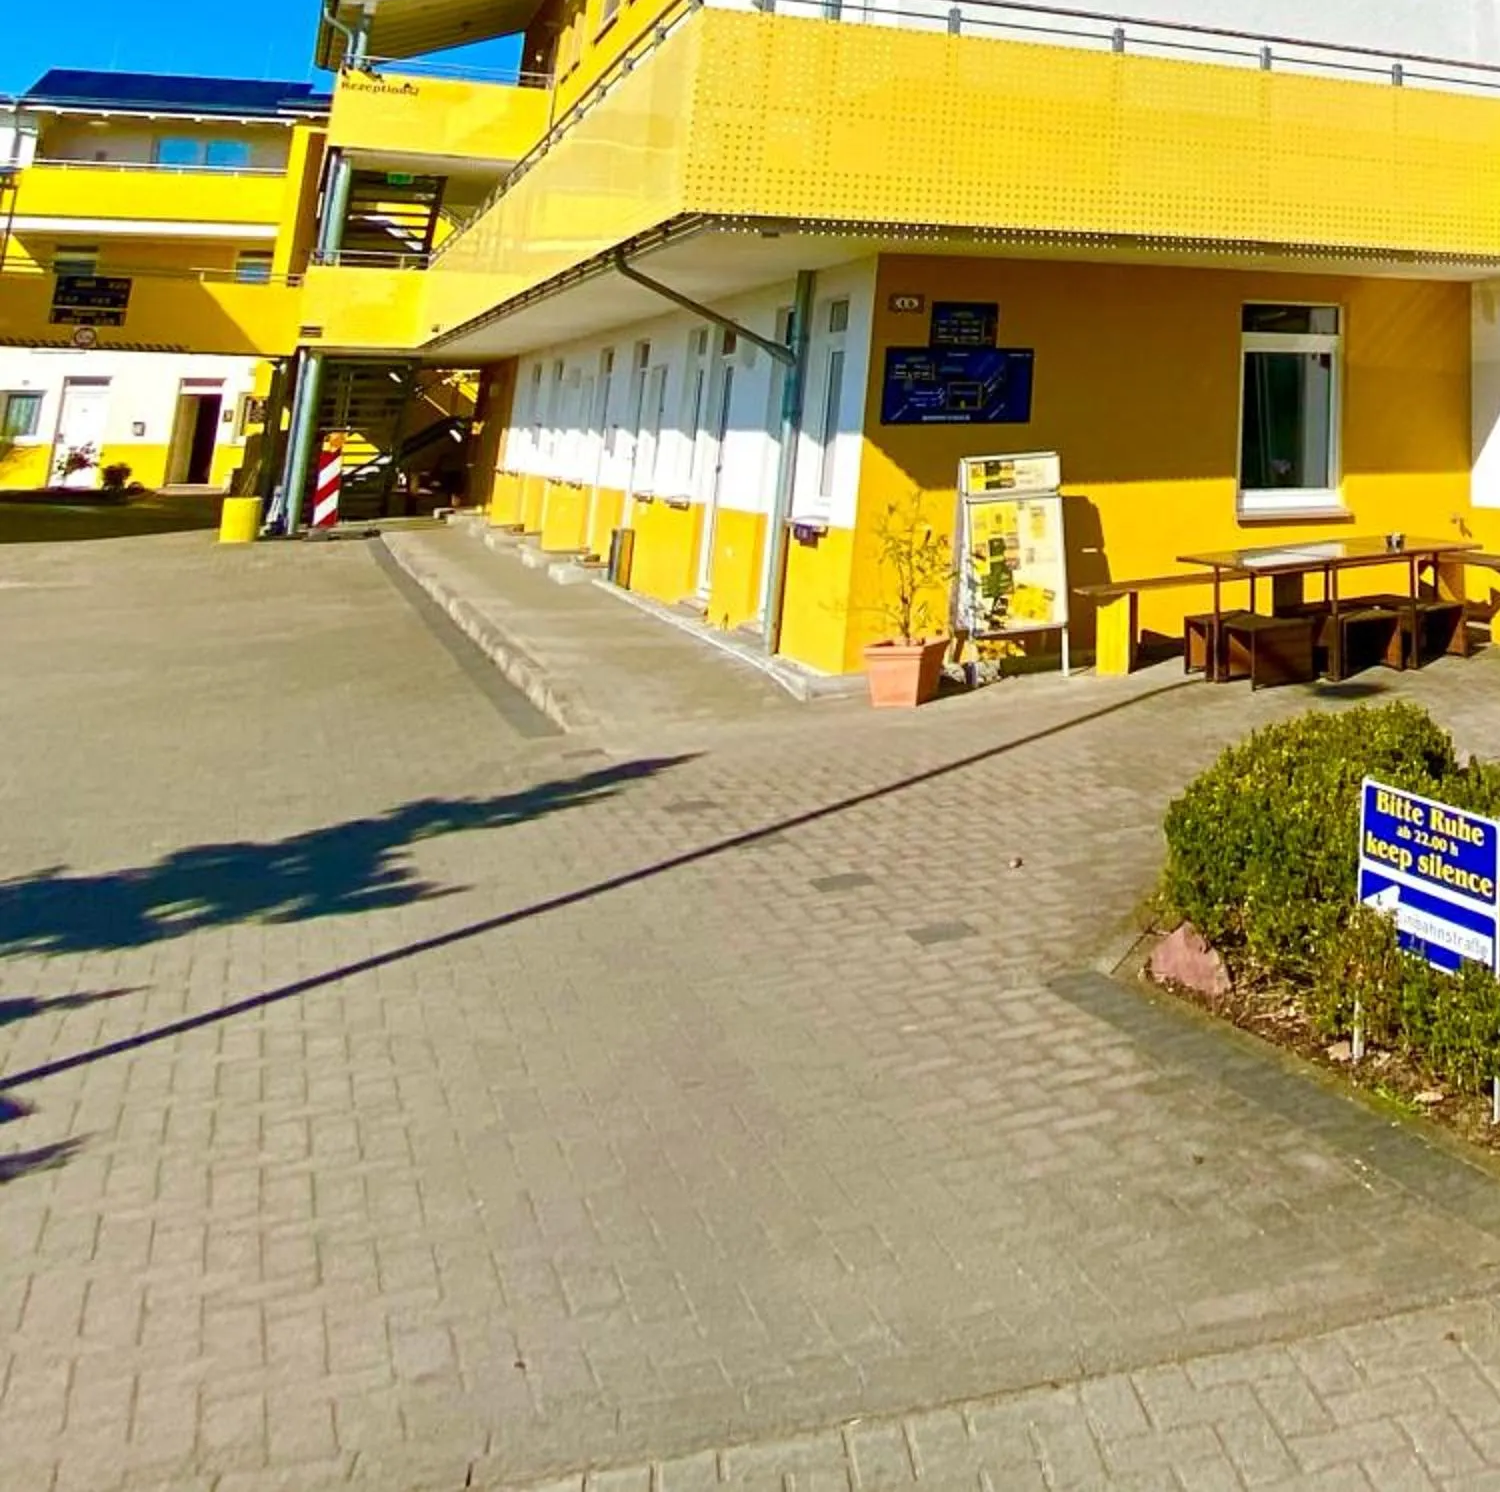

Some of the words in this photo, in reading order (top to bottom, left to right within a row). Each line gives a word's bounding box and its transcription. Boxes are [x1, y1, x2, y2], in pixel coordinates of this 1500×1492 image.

[1376, 790, 1424, 826] Bitte
[1430, 808, 1485, 847] Ruhe
[1396, 825, 1411, 840] ab
[1414, 829, 1448, 853] 22.00
[1450, 841, 1459, 857] h
[1366, 830, 1413, 870] keep
[1417, 853, 1494, 897] silence
